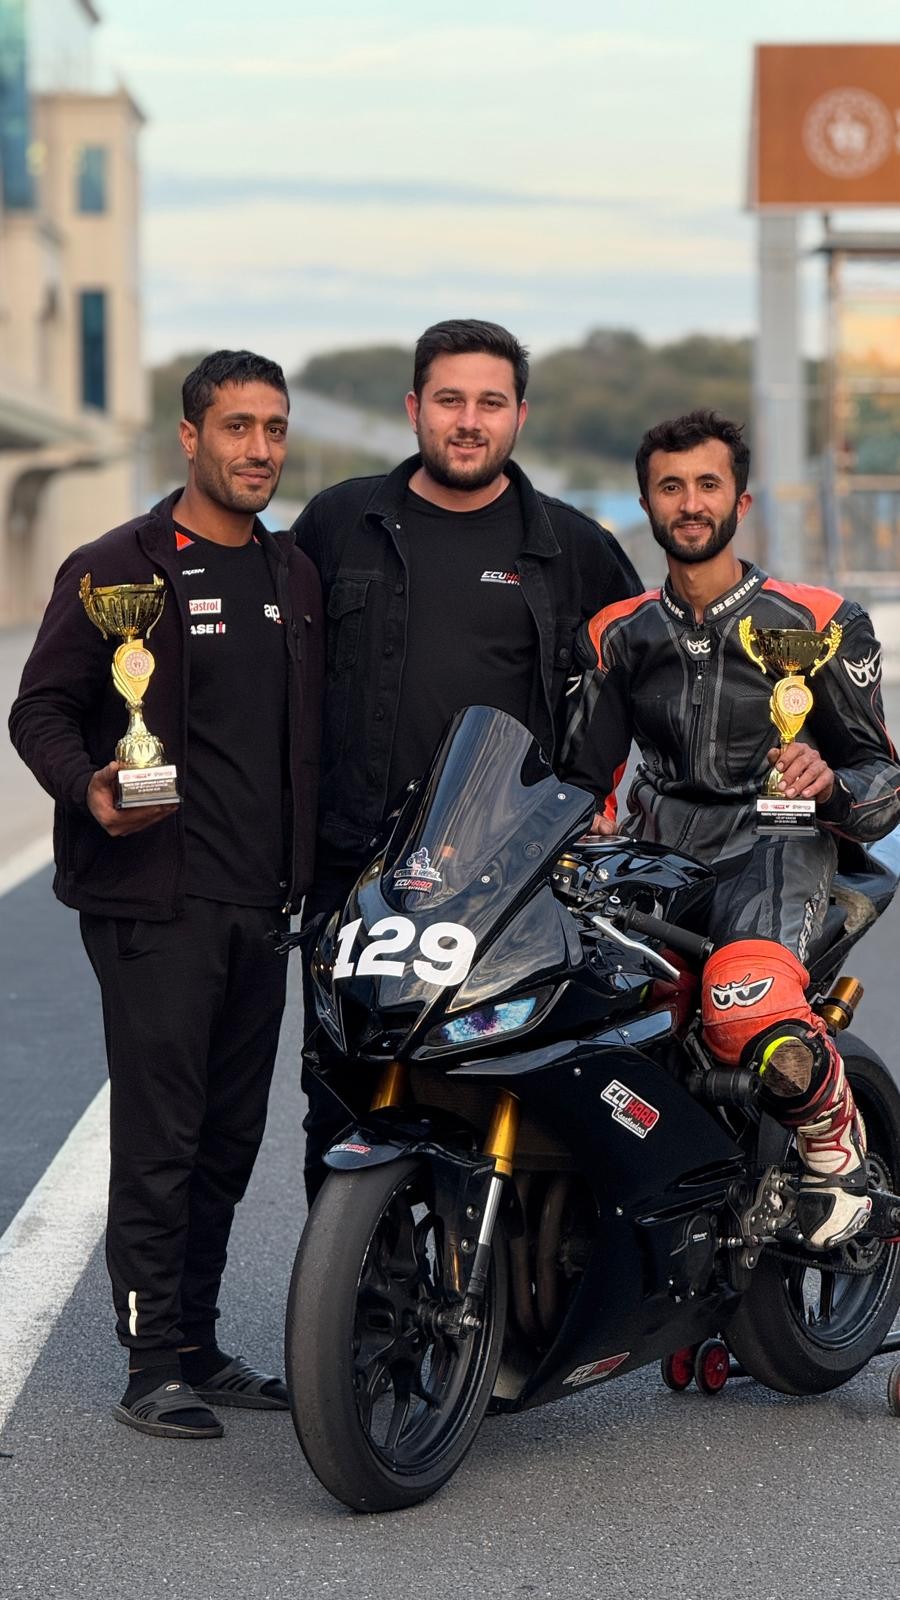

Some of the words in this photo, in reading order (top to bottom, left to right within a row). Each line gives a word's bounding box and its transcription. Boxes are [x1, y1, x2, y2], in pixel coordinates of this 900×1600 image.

[711, 575, 759, 616] BERIK
[333, 915, 477, 986] 129
[603, 1083, 657, 1128] ECUHARD
